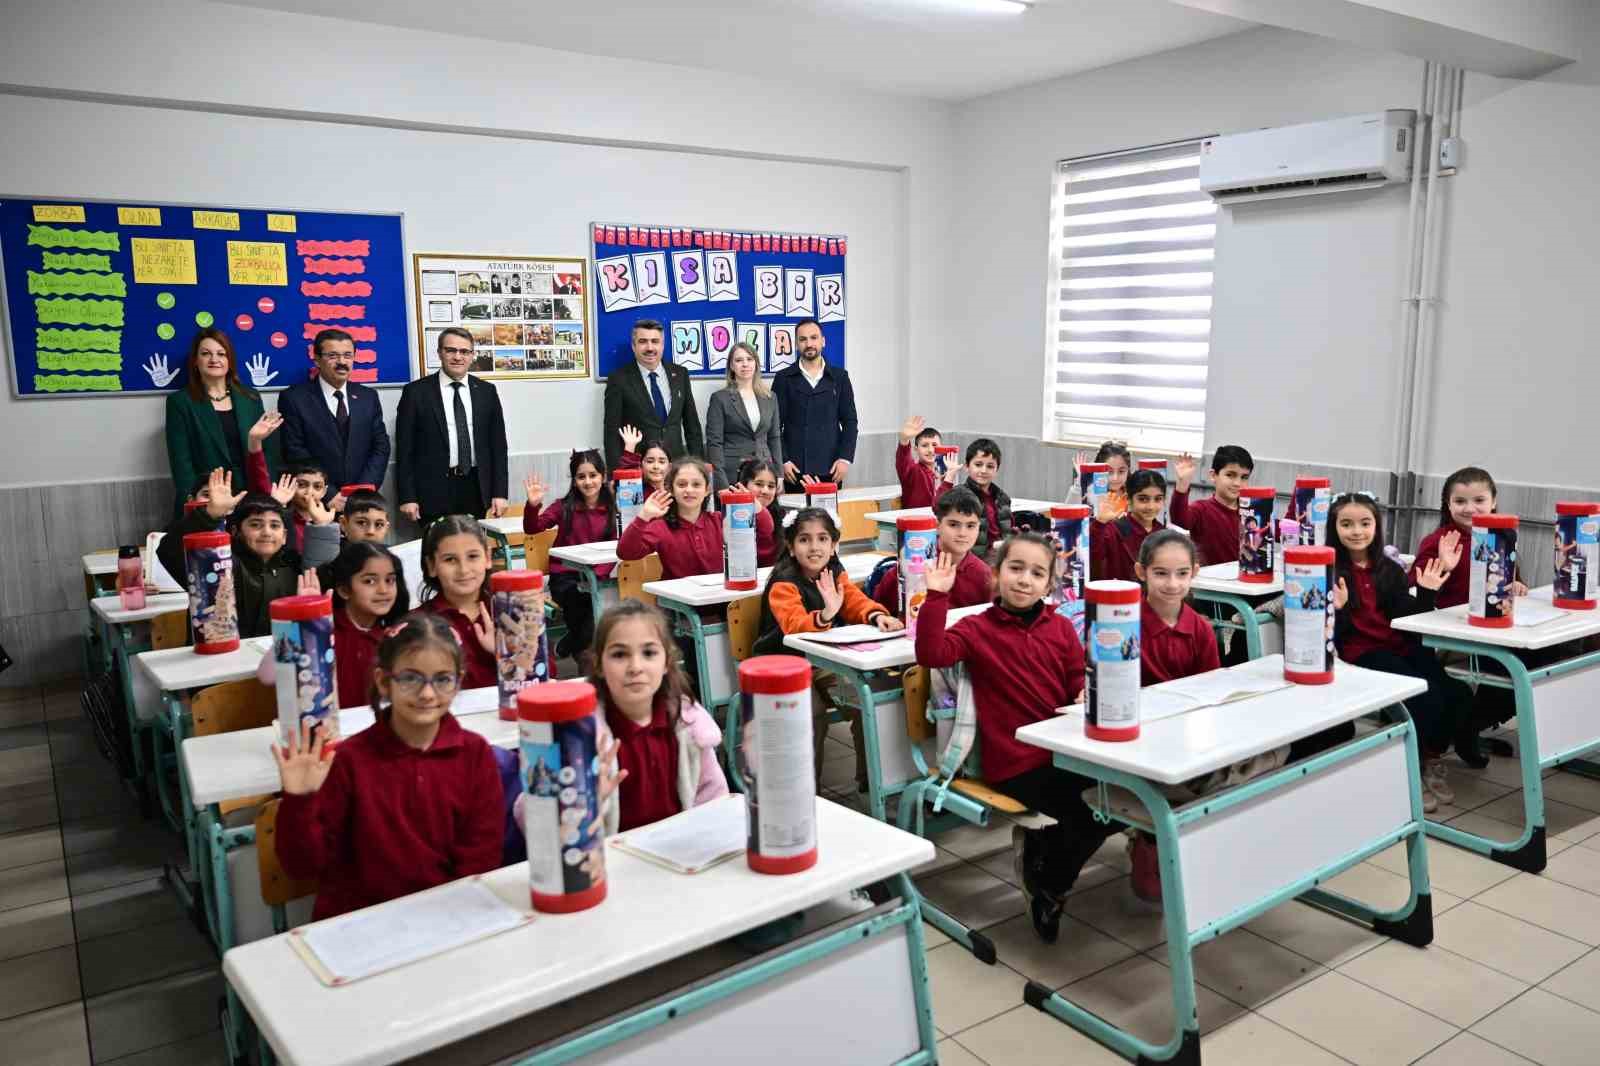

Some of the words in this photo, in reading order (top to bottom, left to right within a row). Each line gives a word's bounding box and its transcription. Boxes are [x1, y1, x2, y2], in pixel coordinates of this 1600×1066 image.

[602, 256, 733, 292] KISA
[760, 271, 842, 306] BİR
[673, 325, 793, 356] MOLA
